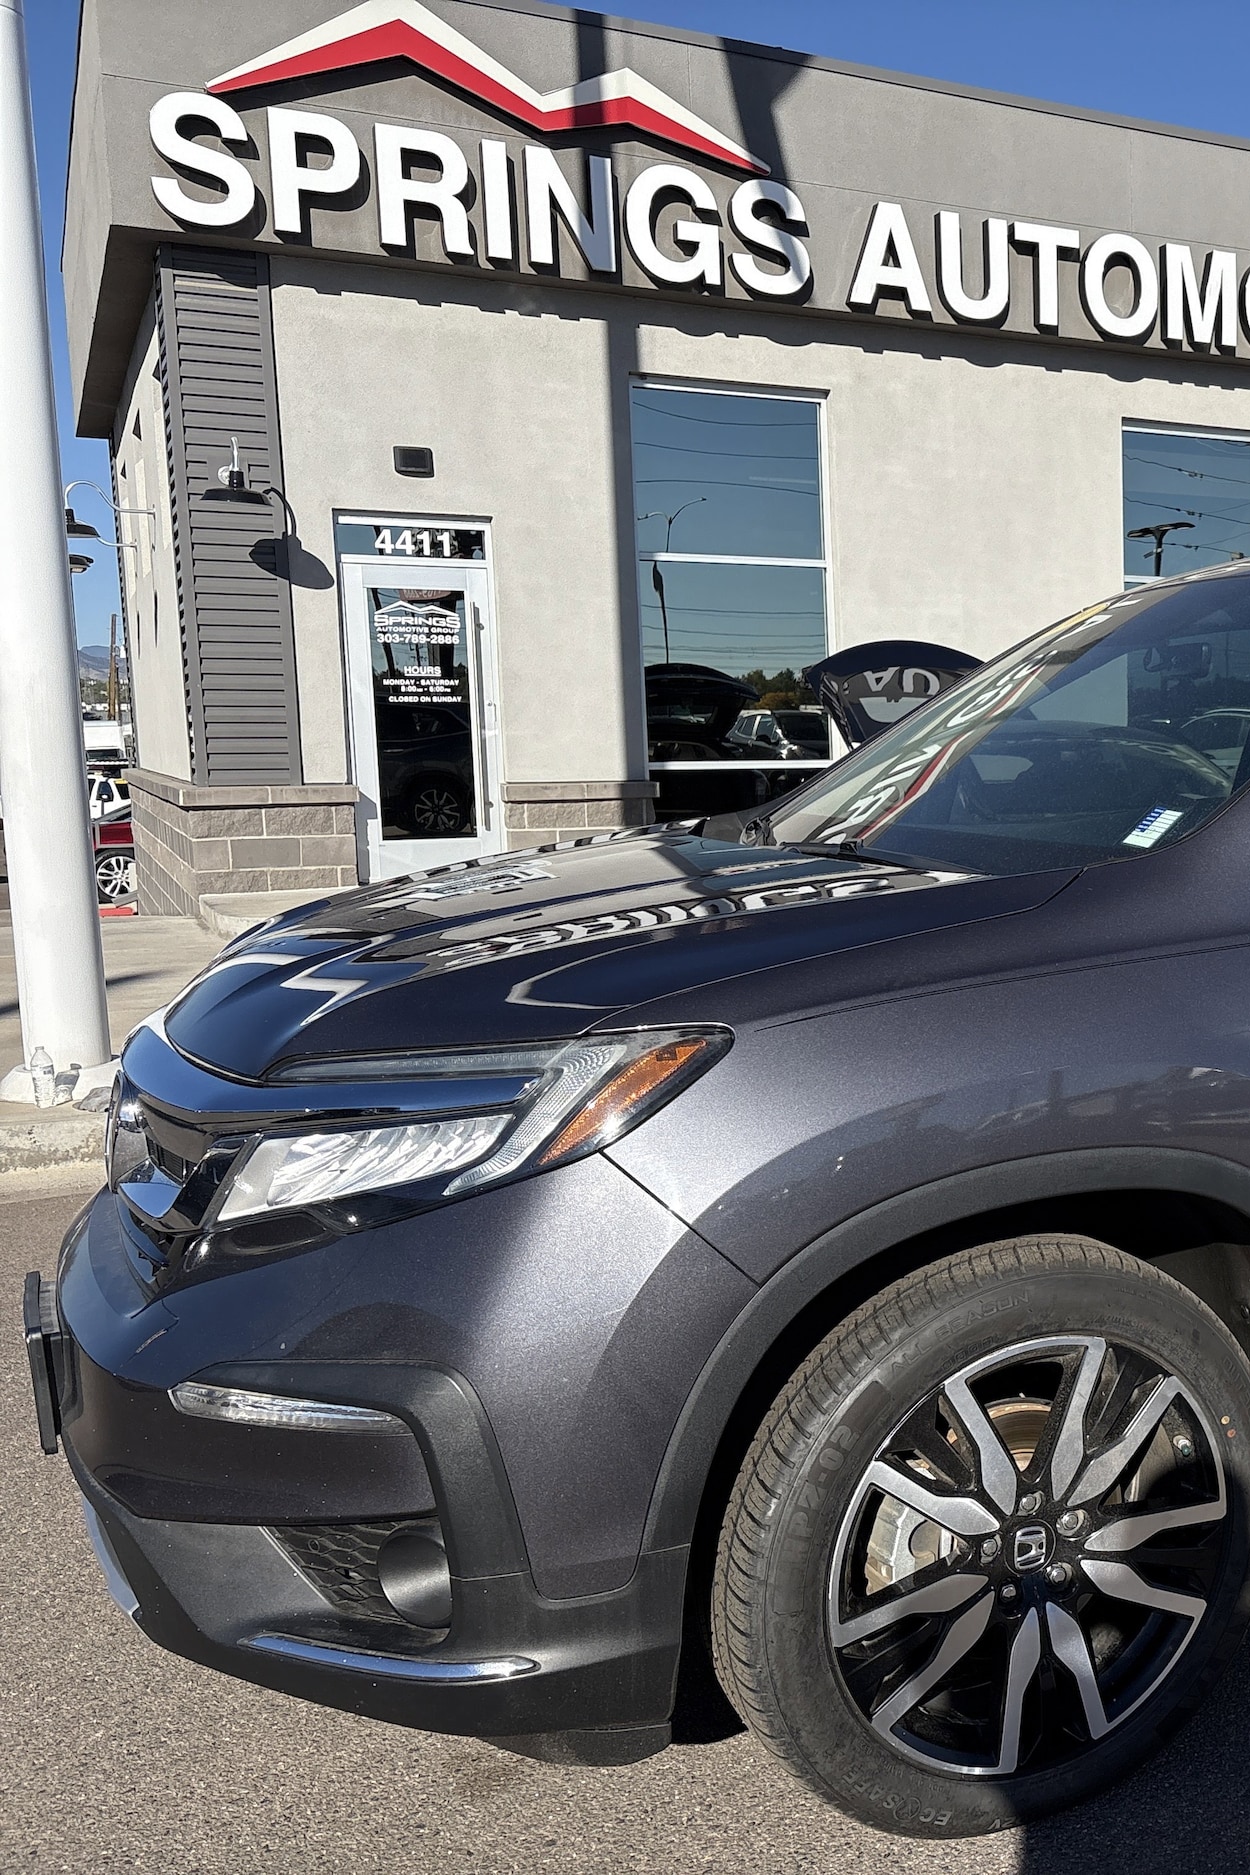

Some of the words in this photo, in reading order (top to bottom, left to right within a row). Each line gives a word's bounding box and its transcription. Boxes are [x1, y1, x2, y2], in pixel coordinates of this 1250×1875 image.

[149, 92, 812, 296] SPRINGS
[374, 528, 451, 557] 4411
[374, 615, 460, 628] SPRINGS
[377, 633, 460, 645] 303-789-2886
[404, 665, 442, 675] HOURS
